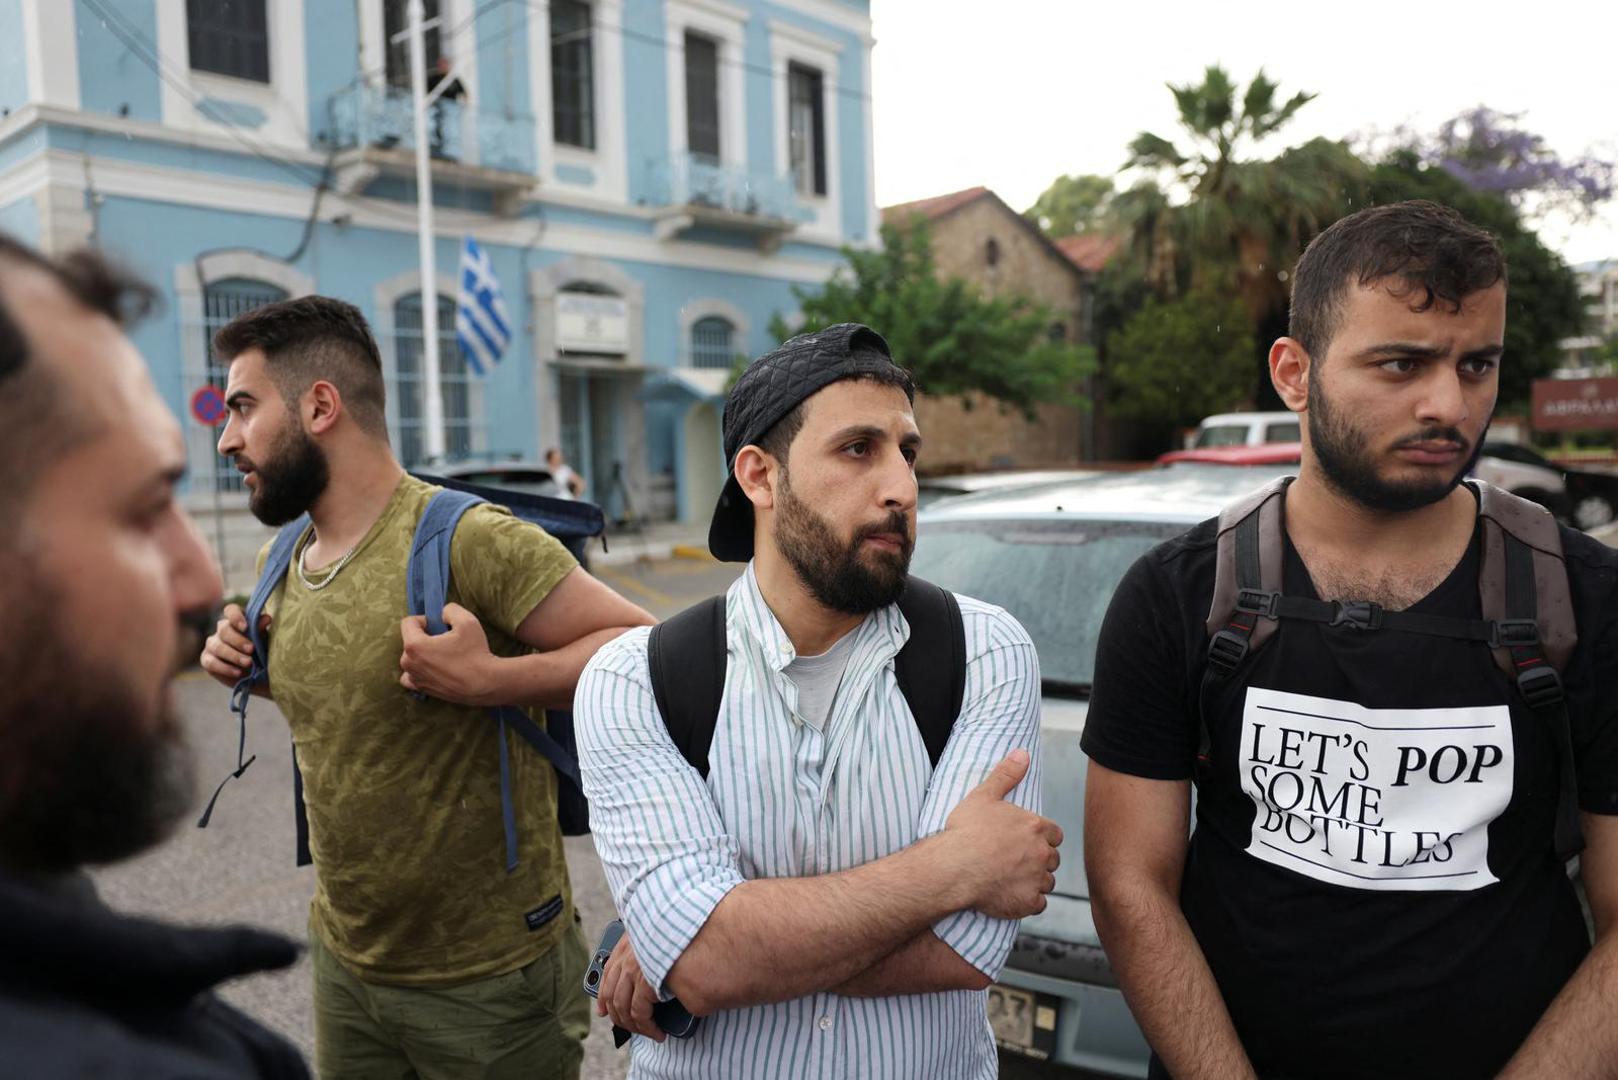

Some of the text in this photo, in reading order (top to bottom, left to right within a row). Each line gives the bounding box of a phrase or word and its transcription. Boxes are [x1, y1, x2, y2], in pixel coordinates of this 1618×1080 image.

[1248, 723, 1503, 787] LET'S POP
[1249, 765, 1384, 828] SOME
[1259, 808, 1464, 868] BOTTLES
